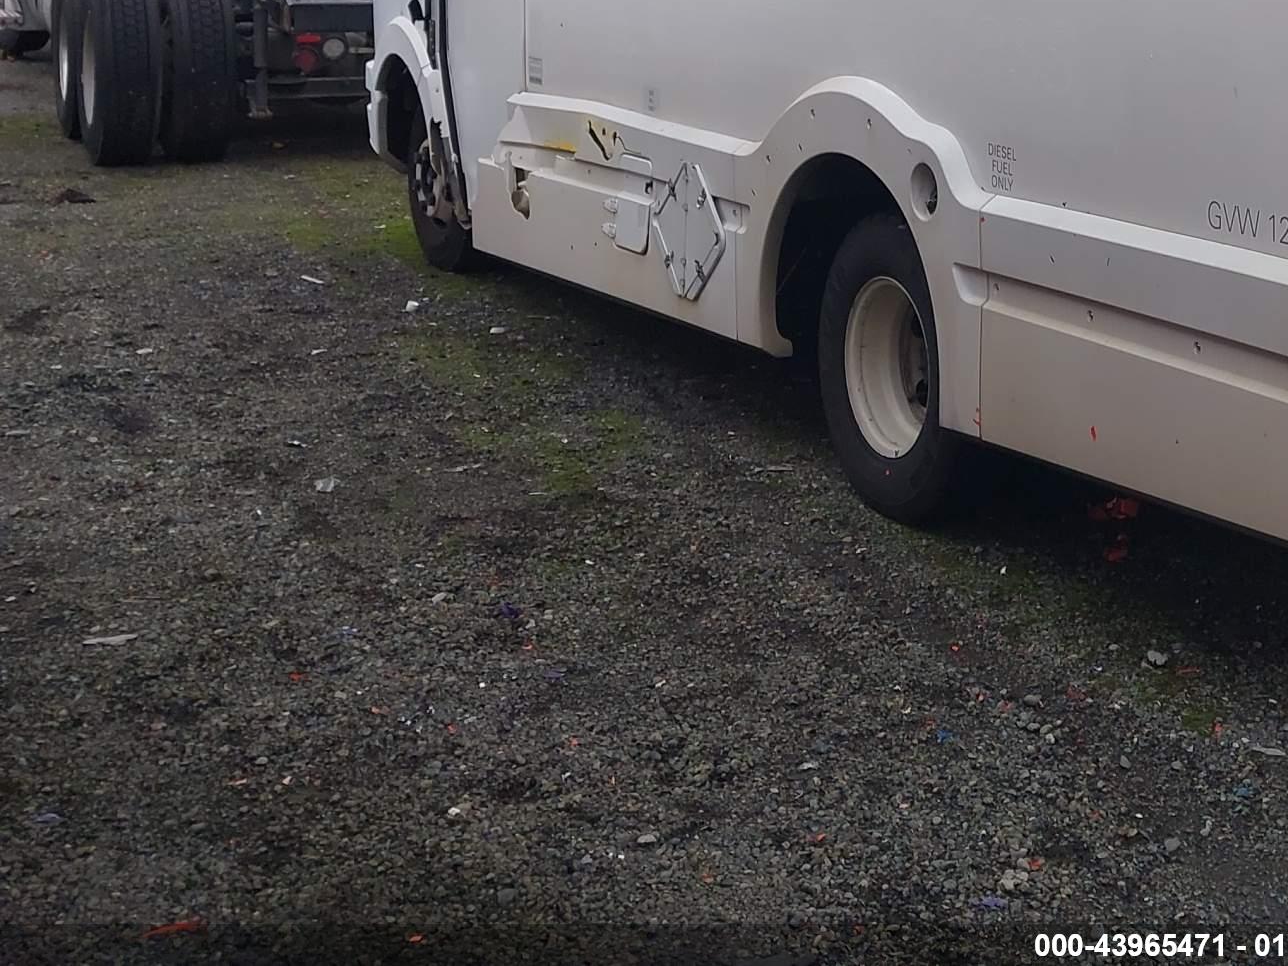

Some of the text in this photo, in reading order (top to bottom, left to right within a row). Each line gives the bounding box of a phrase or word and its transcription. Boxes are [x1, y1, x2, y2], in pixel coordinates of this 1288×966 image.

[988, 142, 1017, 162] DIESEL
[992, 159, 1013, 177] FUEL
[992, 174, 1014, 192] ONLY
[1208, 200, 1261, 238] GVW
